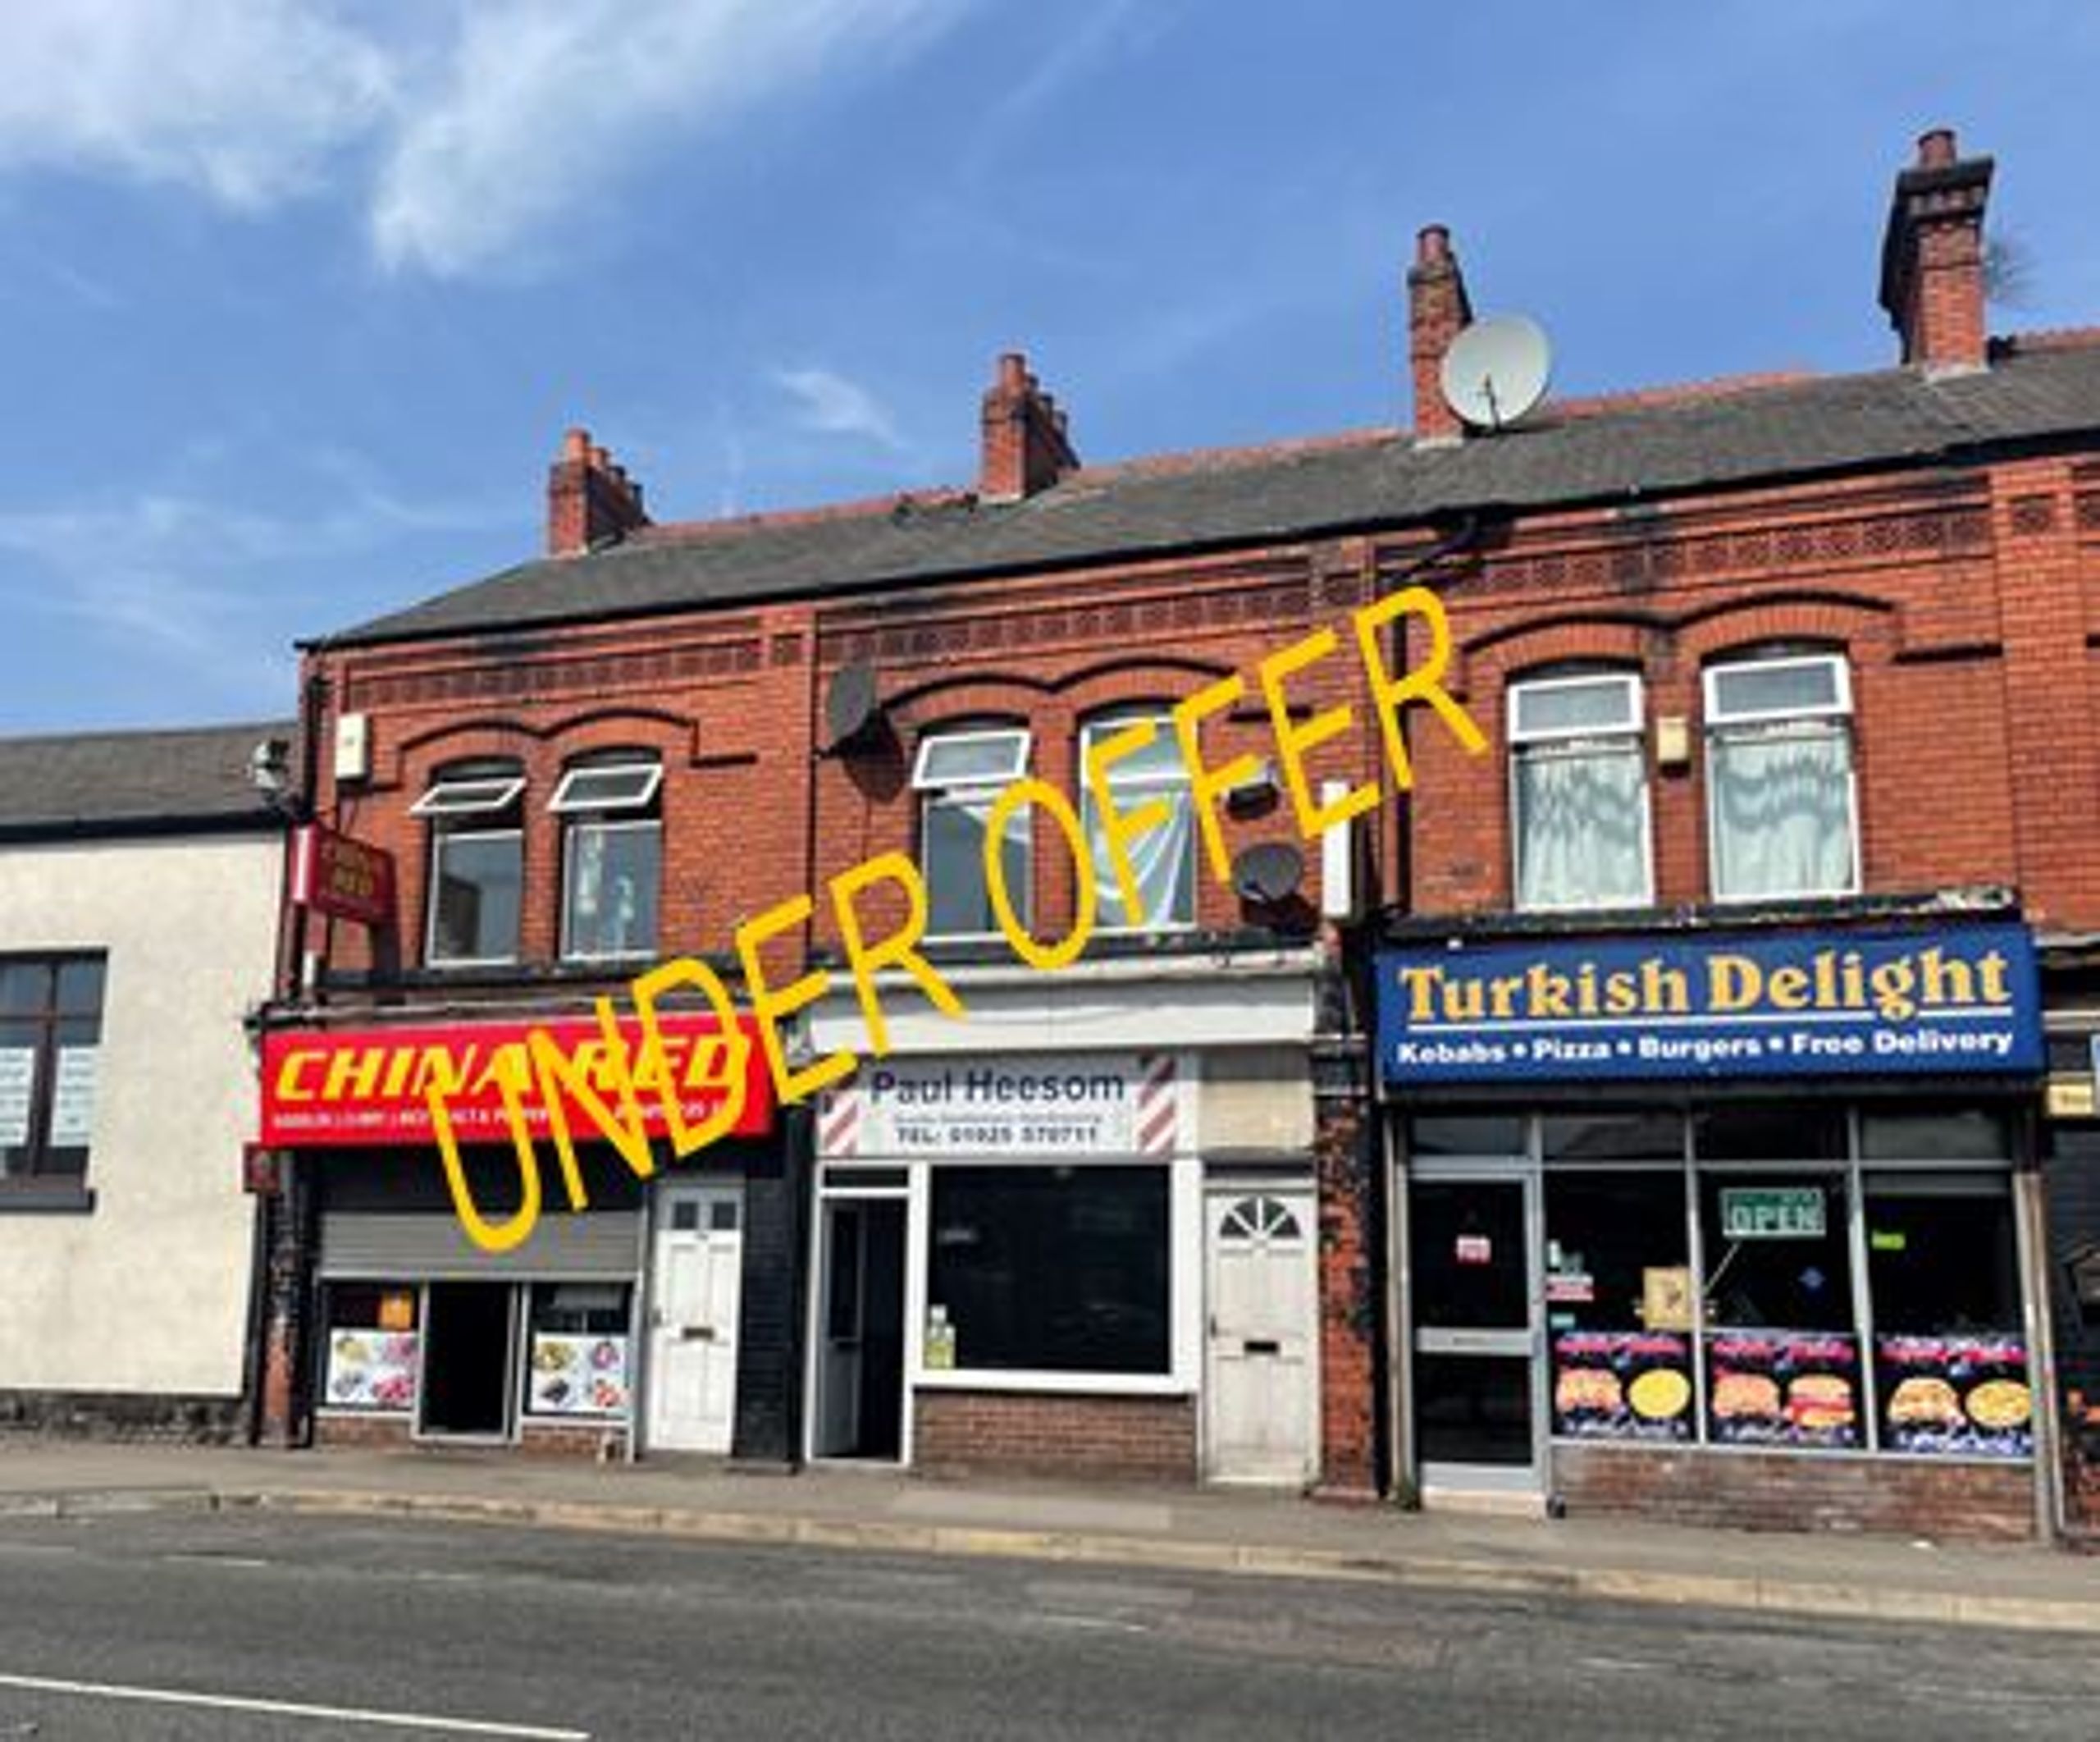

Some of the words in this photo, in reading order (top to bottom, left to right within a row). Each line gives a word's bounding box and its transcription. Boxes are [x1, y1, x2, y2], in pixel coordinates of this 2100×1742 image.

[1400, 956, 1690, 1022] Turkish
[1708, 947, 2016, 1019] Delight
[1397, 1034, 1506, 1064] Kebabs
[1532, 1037, 1611, 1060] Pizza
[1638, 1036, 1761, 1062] Burgers
[1792, 1032, 1864, 1055] Free
[1874, 1028, 2014, 1055] Delivery
[275, 1041, 533, 1100] CHINA
[871, 1070, 952, 1104] Paul
[966, 1068, 1125, 1101] Heesom
